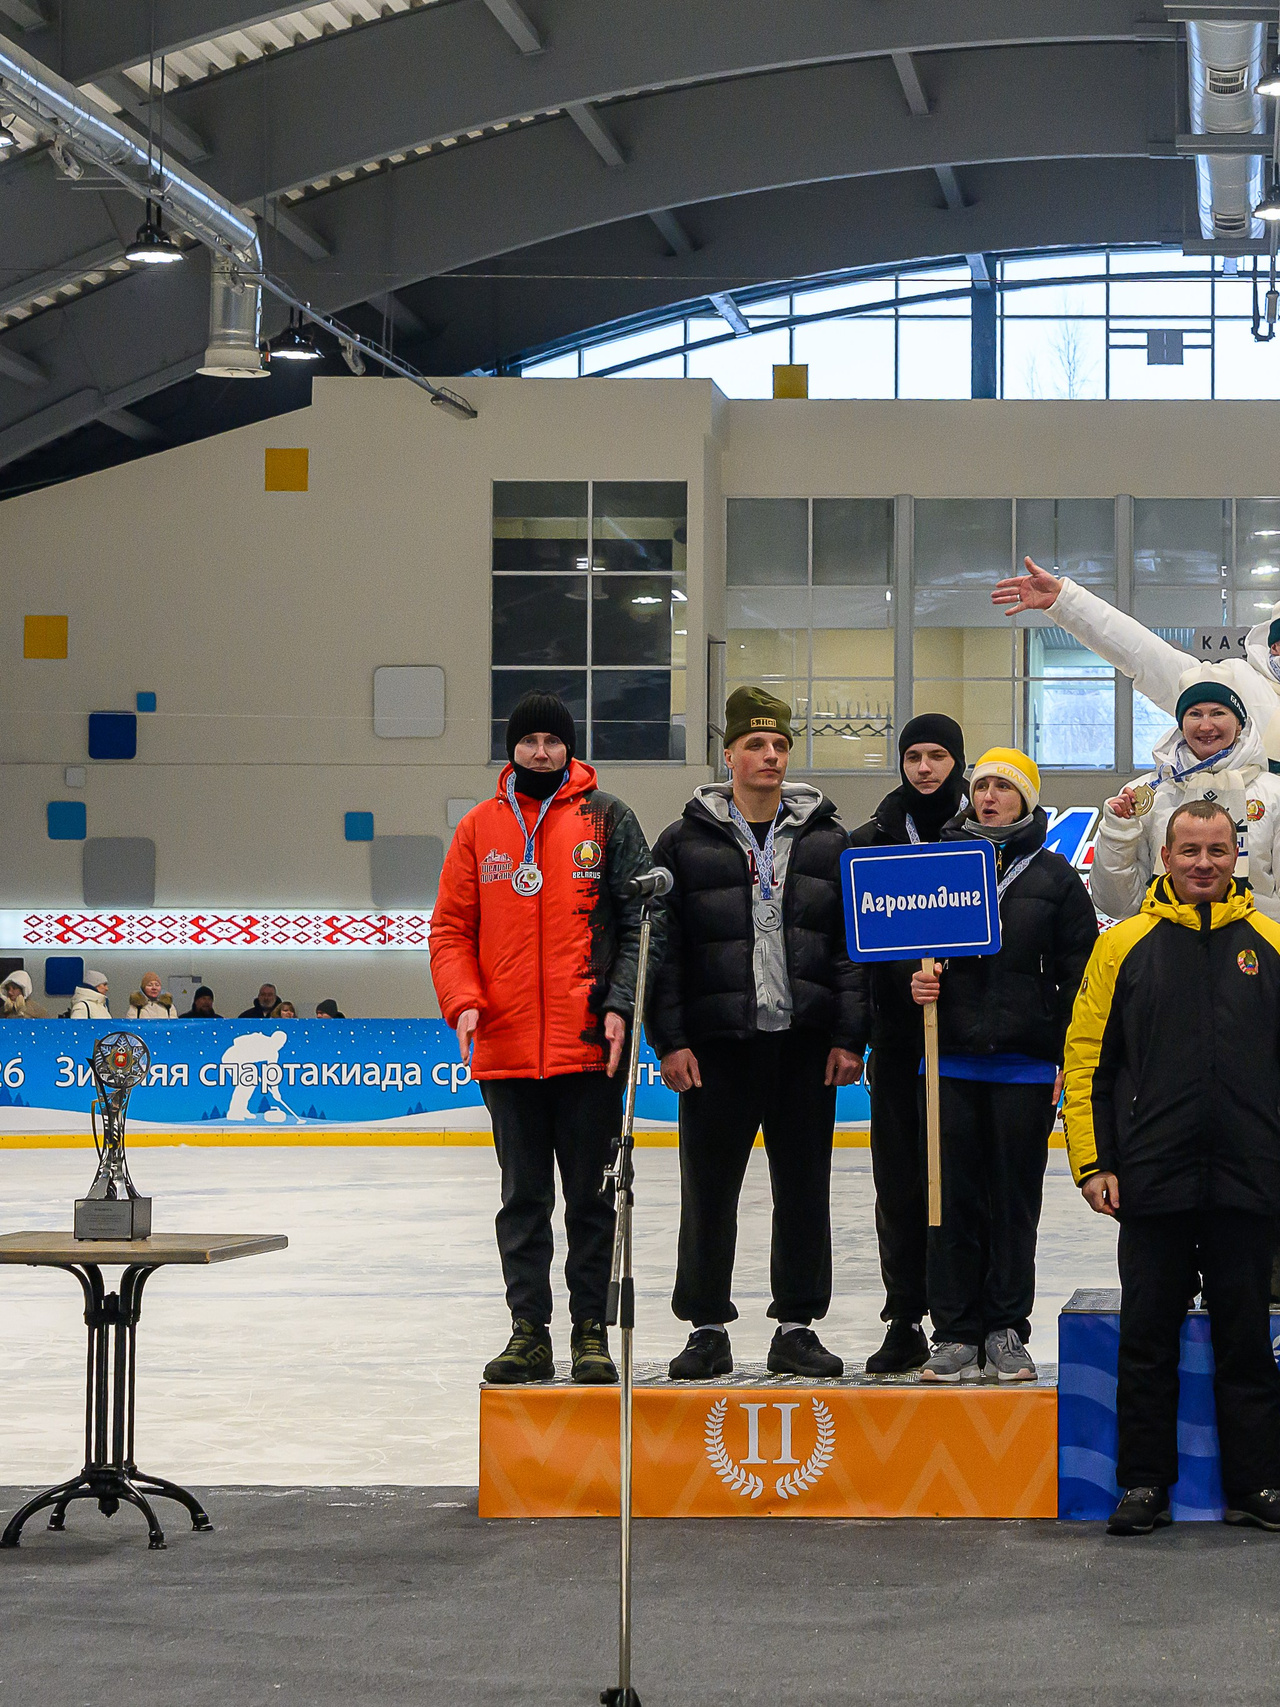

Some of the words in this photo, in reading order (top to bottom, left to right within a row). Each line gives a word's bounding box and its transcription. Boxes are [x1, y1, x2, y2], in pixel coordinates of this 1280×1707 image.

[572, 871, 600, 879] BELARUS
[861, 886, 982, 918] Агрохолдинг
[0, 1057, 25, 1088] 6
[55, 1056, 189, 1088] Зияя
[199, 1061, 422, 1094] спартакиада
